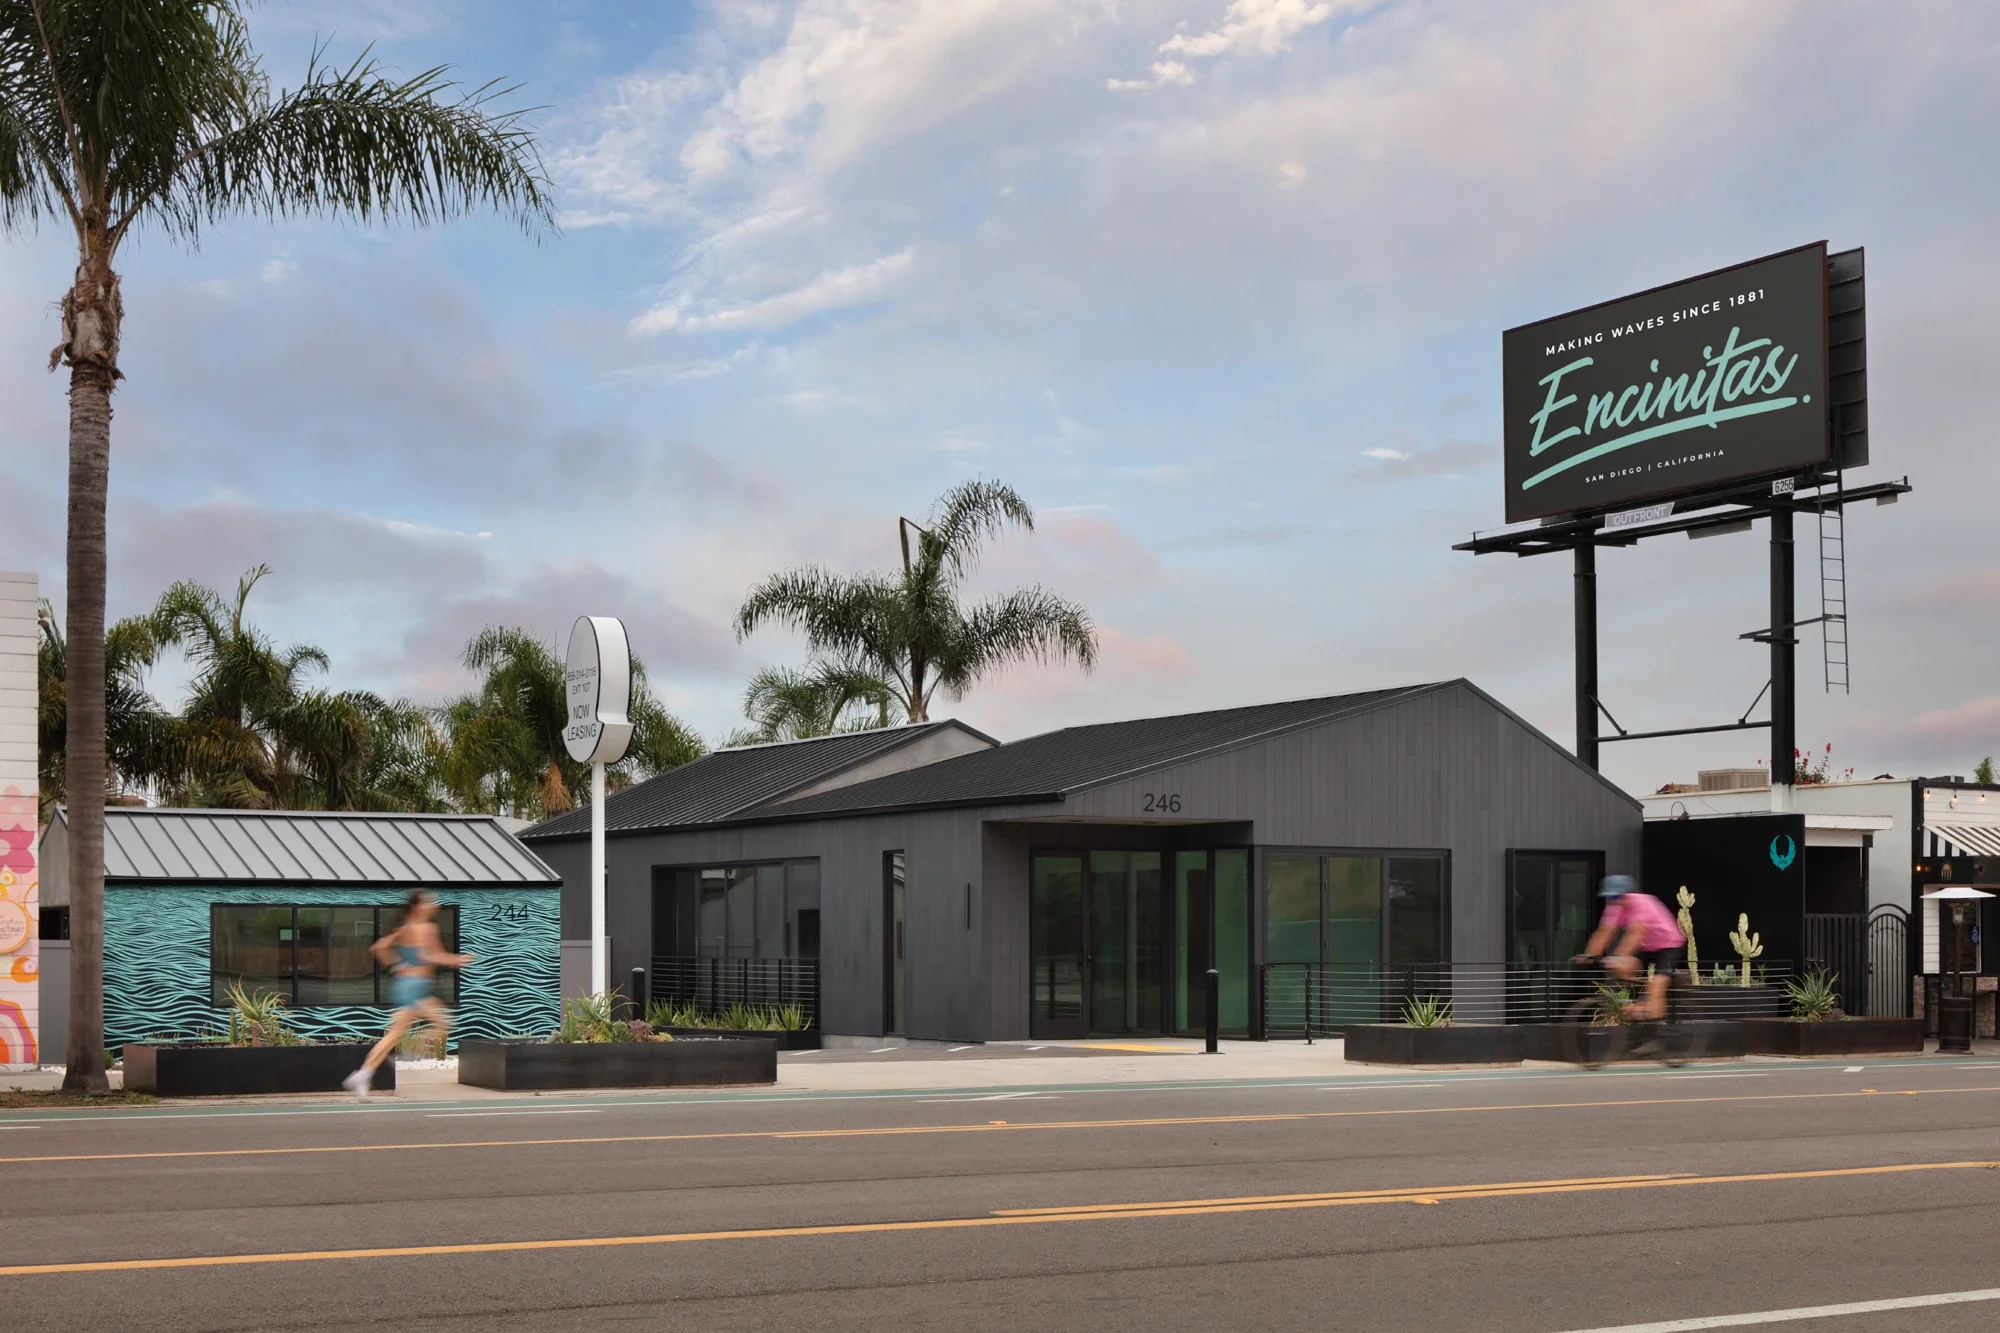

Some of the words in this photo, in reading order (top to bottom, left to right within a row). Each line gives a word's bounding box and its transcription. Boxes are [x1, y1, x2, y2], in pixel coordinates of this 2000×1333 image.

[1545, 332, 1604, 356] MAKING
[1611, 316, 1665, 338] WAVES
[1672, 301, 1721, 323] SINCE
[1729, 289, 1765, 308] 1881
[1585, 473, 1604, 483] SAN
[1610, 466, 1642, 478] DIEGO
[1657, 449, 1725, 468] CALIFORNIA
[1775, 478, 1794, 493] 6255
[1613, 506, 1668, 526] OUTFRONT
[573, 703, 590, 720] NOW
[567, 723, 597, 741] LEASING
[1143, 793, 1181, 813] 246
[491, 904, 529, 920] 244
